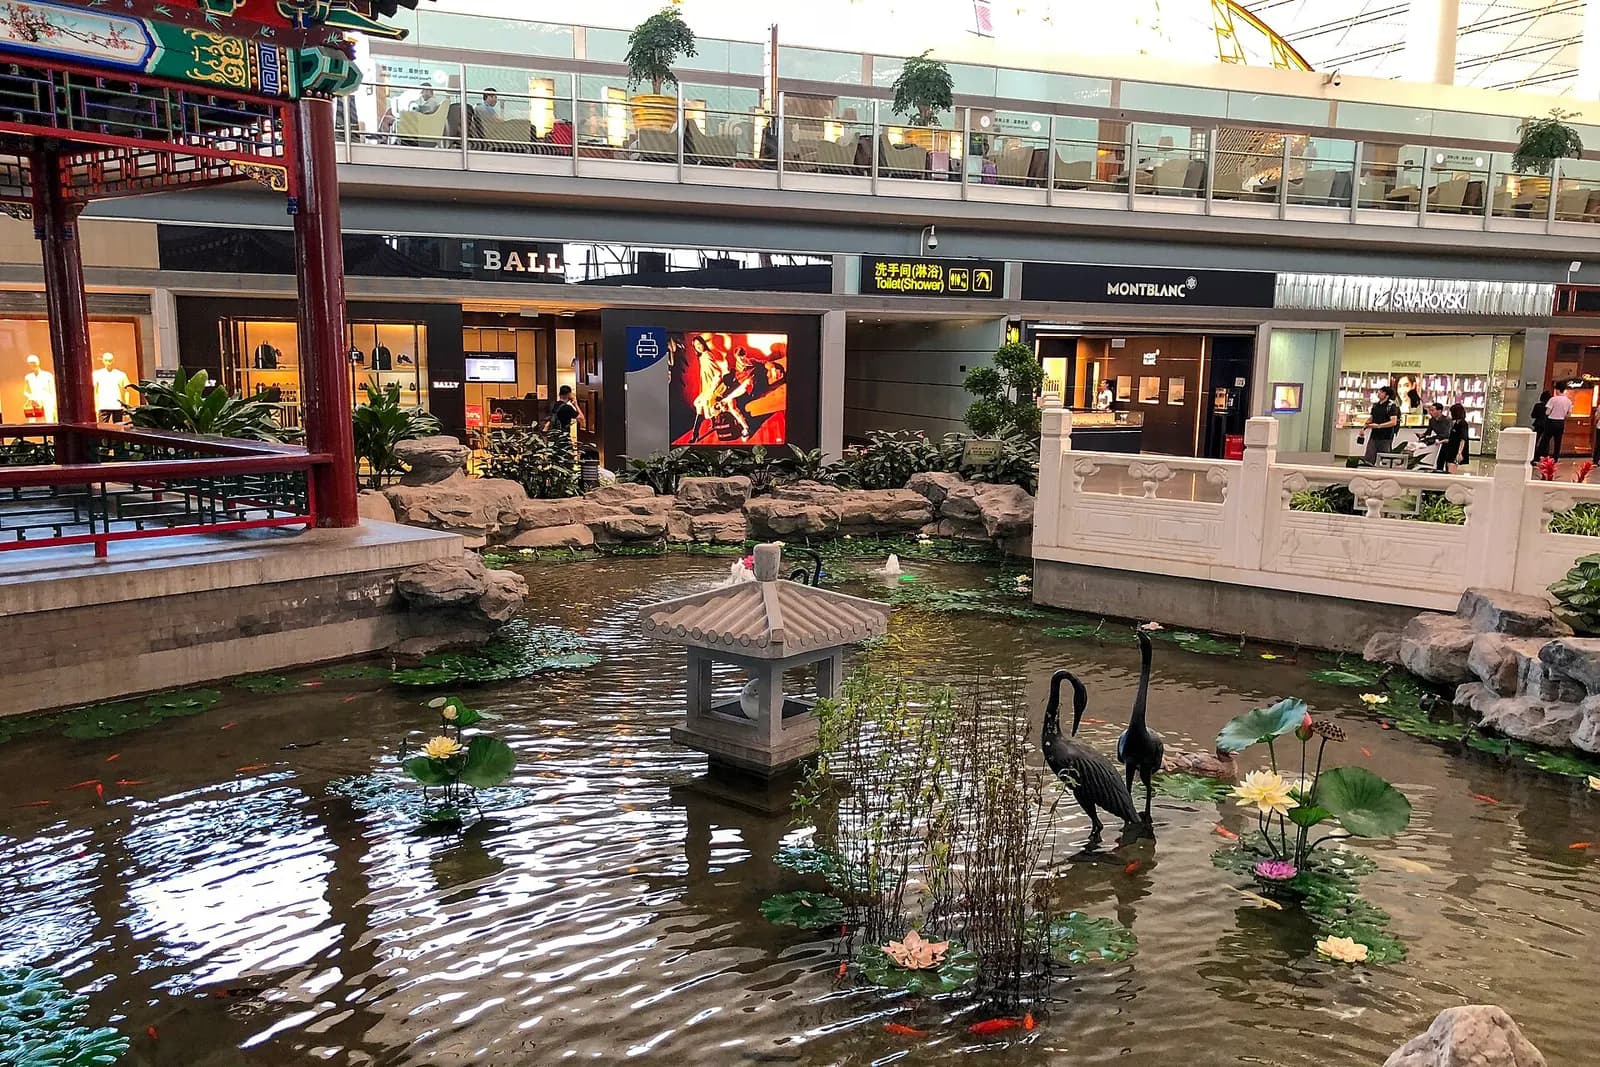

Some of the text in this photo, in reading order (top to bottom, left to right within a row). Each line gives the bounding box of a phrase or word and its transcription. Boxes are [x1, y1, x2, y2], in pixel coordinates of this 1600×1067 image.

[483, 249, 566, 274] BALL
[874, 262, 944, 279] 洗手间(淋浴)
[874, 277, 945, 293] Toilet(Shower)
[1107, 282, 1186, 298] MONTBLANC
[1393, 289, 1468, 309] SWAROVSKI
[432, 381, 460, 389] BALLY
